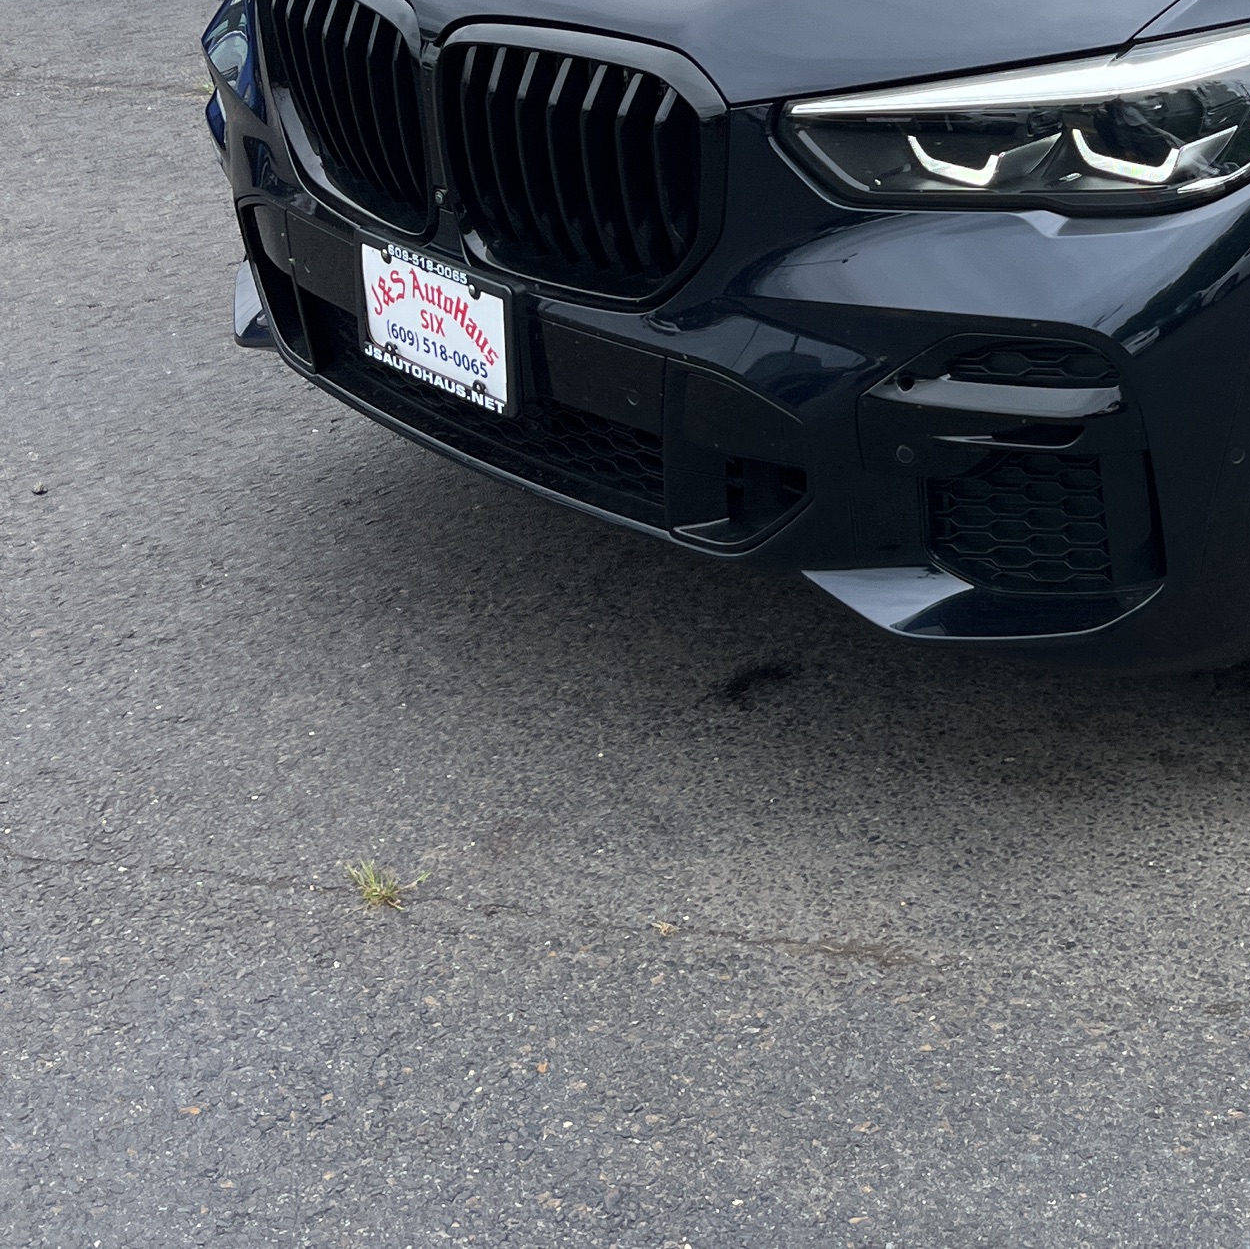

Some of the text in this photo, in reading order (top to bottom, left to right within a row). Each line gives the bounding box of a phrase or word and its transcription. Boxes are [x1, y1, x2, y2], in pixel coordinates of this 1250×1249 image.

[387, 244, 468, 285] 609-518-0065
[371, 268, 500, 366] J&S AutoHaus
[420, 309, 446, 338] SIX
[386, 319, 489, 379] (609) 518-0065
[364, 345, 505, 414] JSAUTOHAUS.NET
